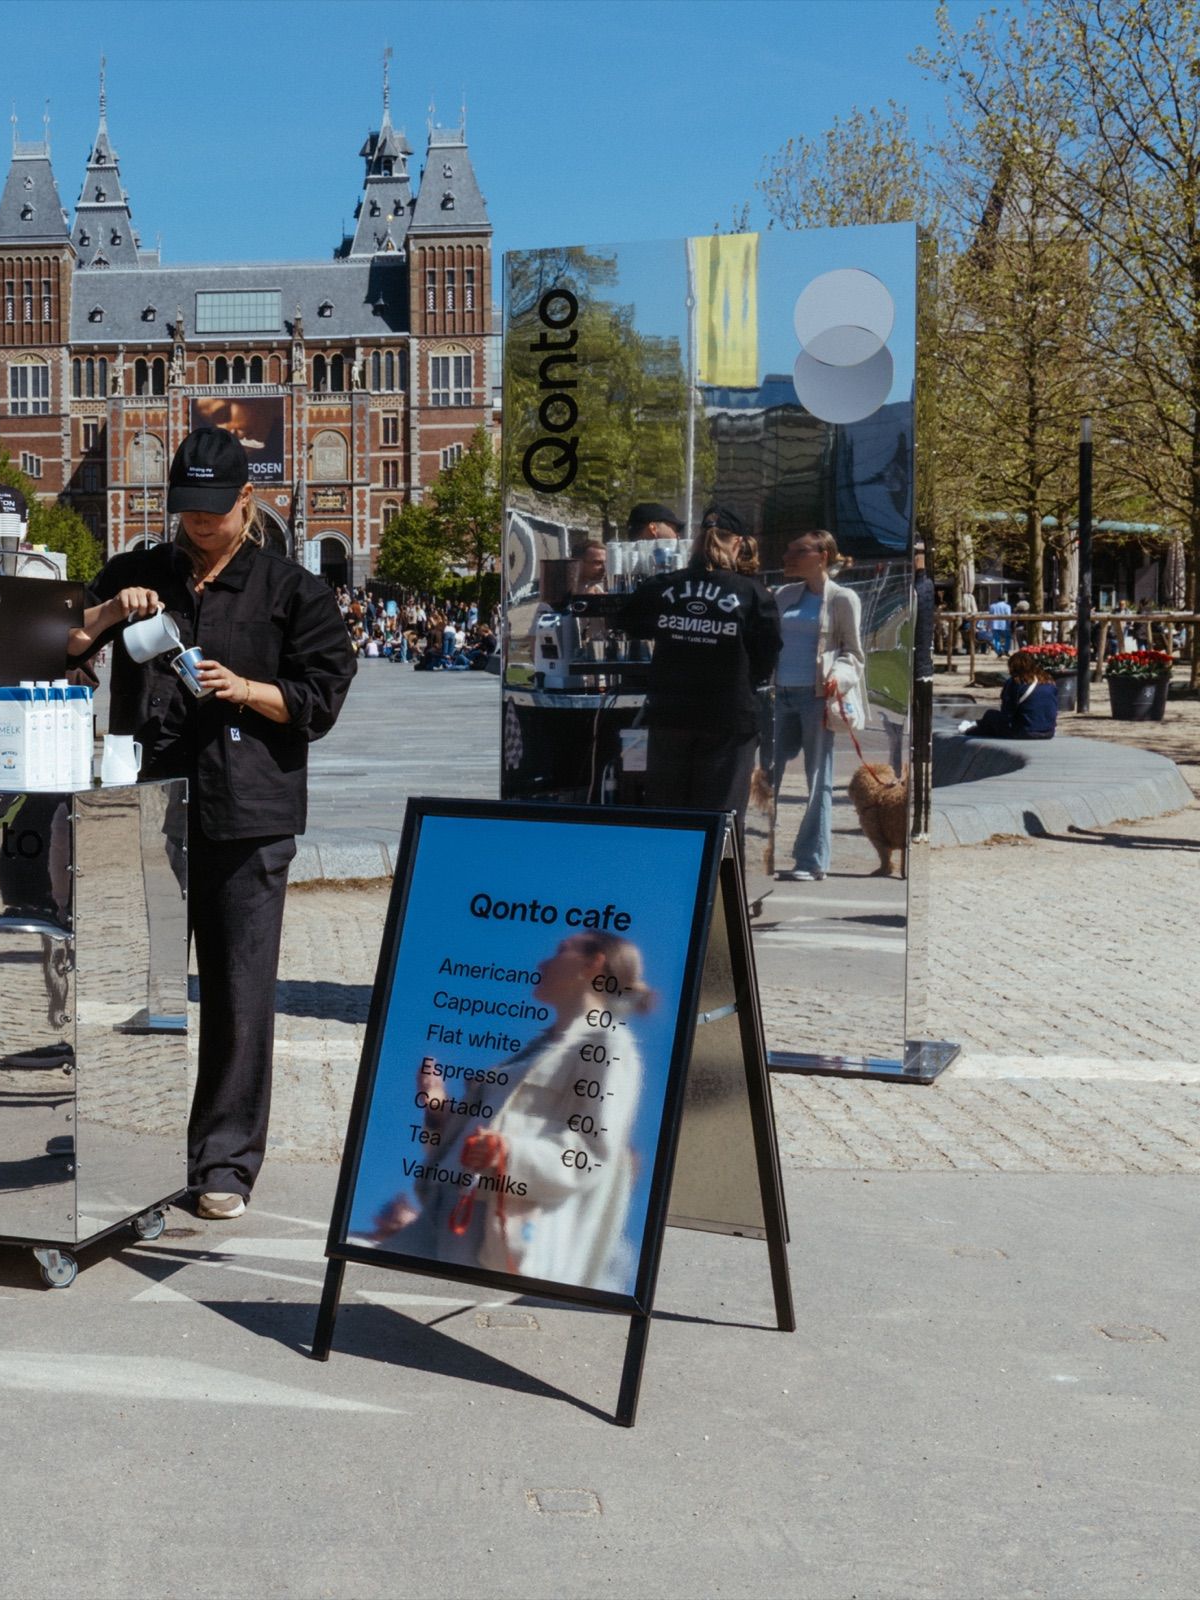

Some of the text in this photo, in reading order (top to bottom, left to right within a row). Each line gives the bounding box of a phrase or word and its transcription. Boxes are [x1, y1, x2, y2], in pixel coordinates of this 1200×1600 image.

[522, 288, 579, 494] Qonto
[470, 893, 632, 932] Qonto cafe
[438, 958, 632, 997] Americano €0,-
[433, 991, 626, 1031] Cappuccino €0,-
[426, 1023, 620, 1067] Flat white €0,-
[420, 1056, 614, 1102] Espresso €0,-
[414, 1091, 608, 1138] Cortado €0,-
[409, 1124, 602, 1173] Tea €0,-
[402, 1158, 528, 1196] Various milks
